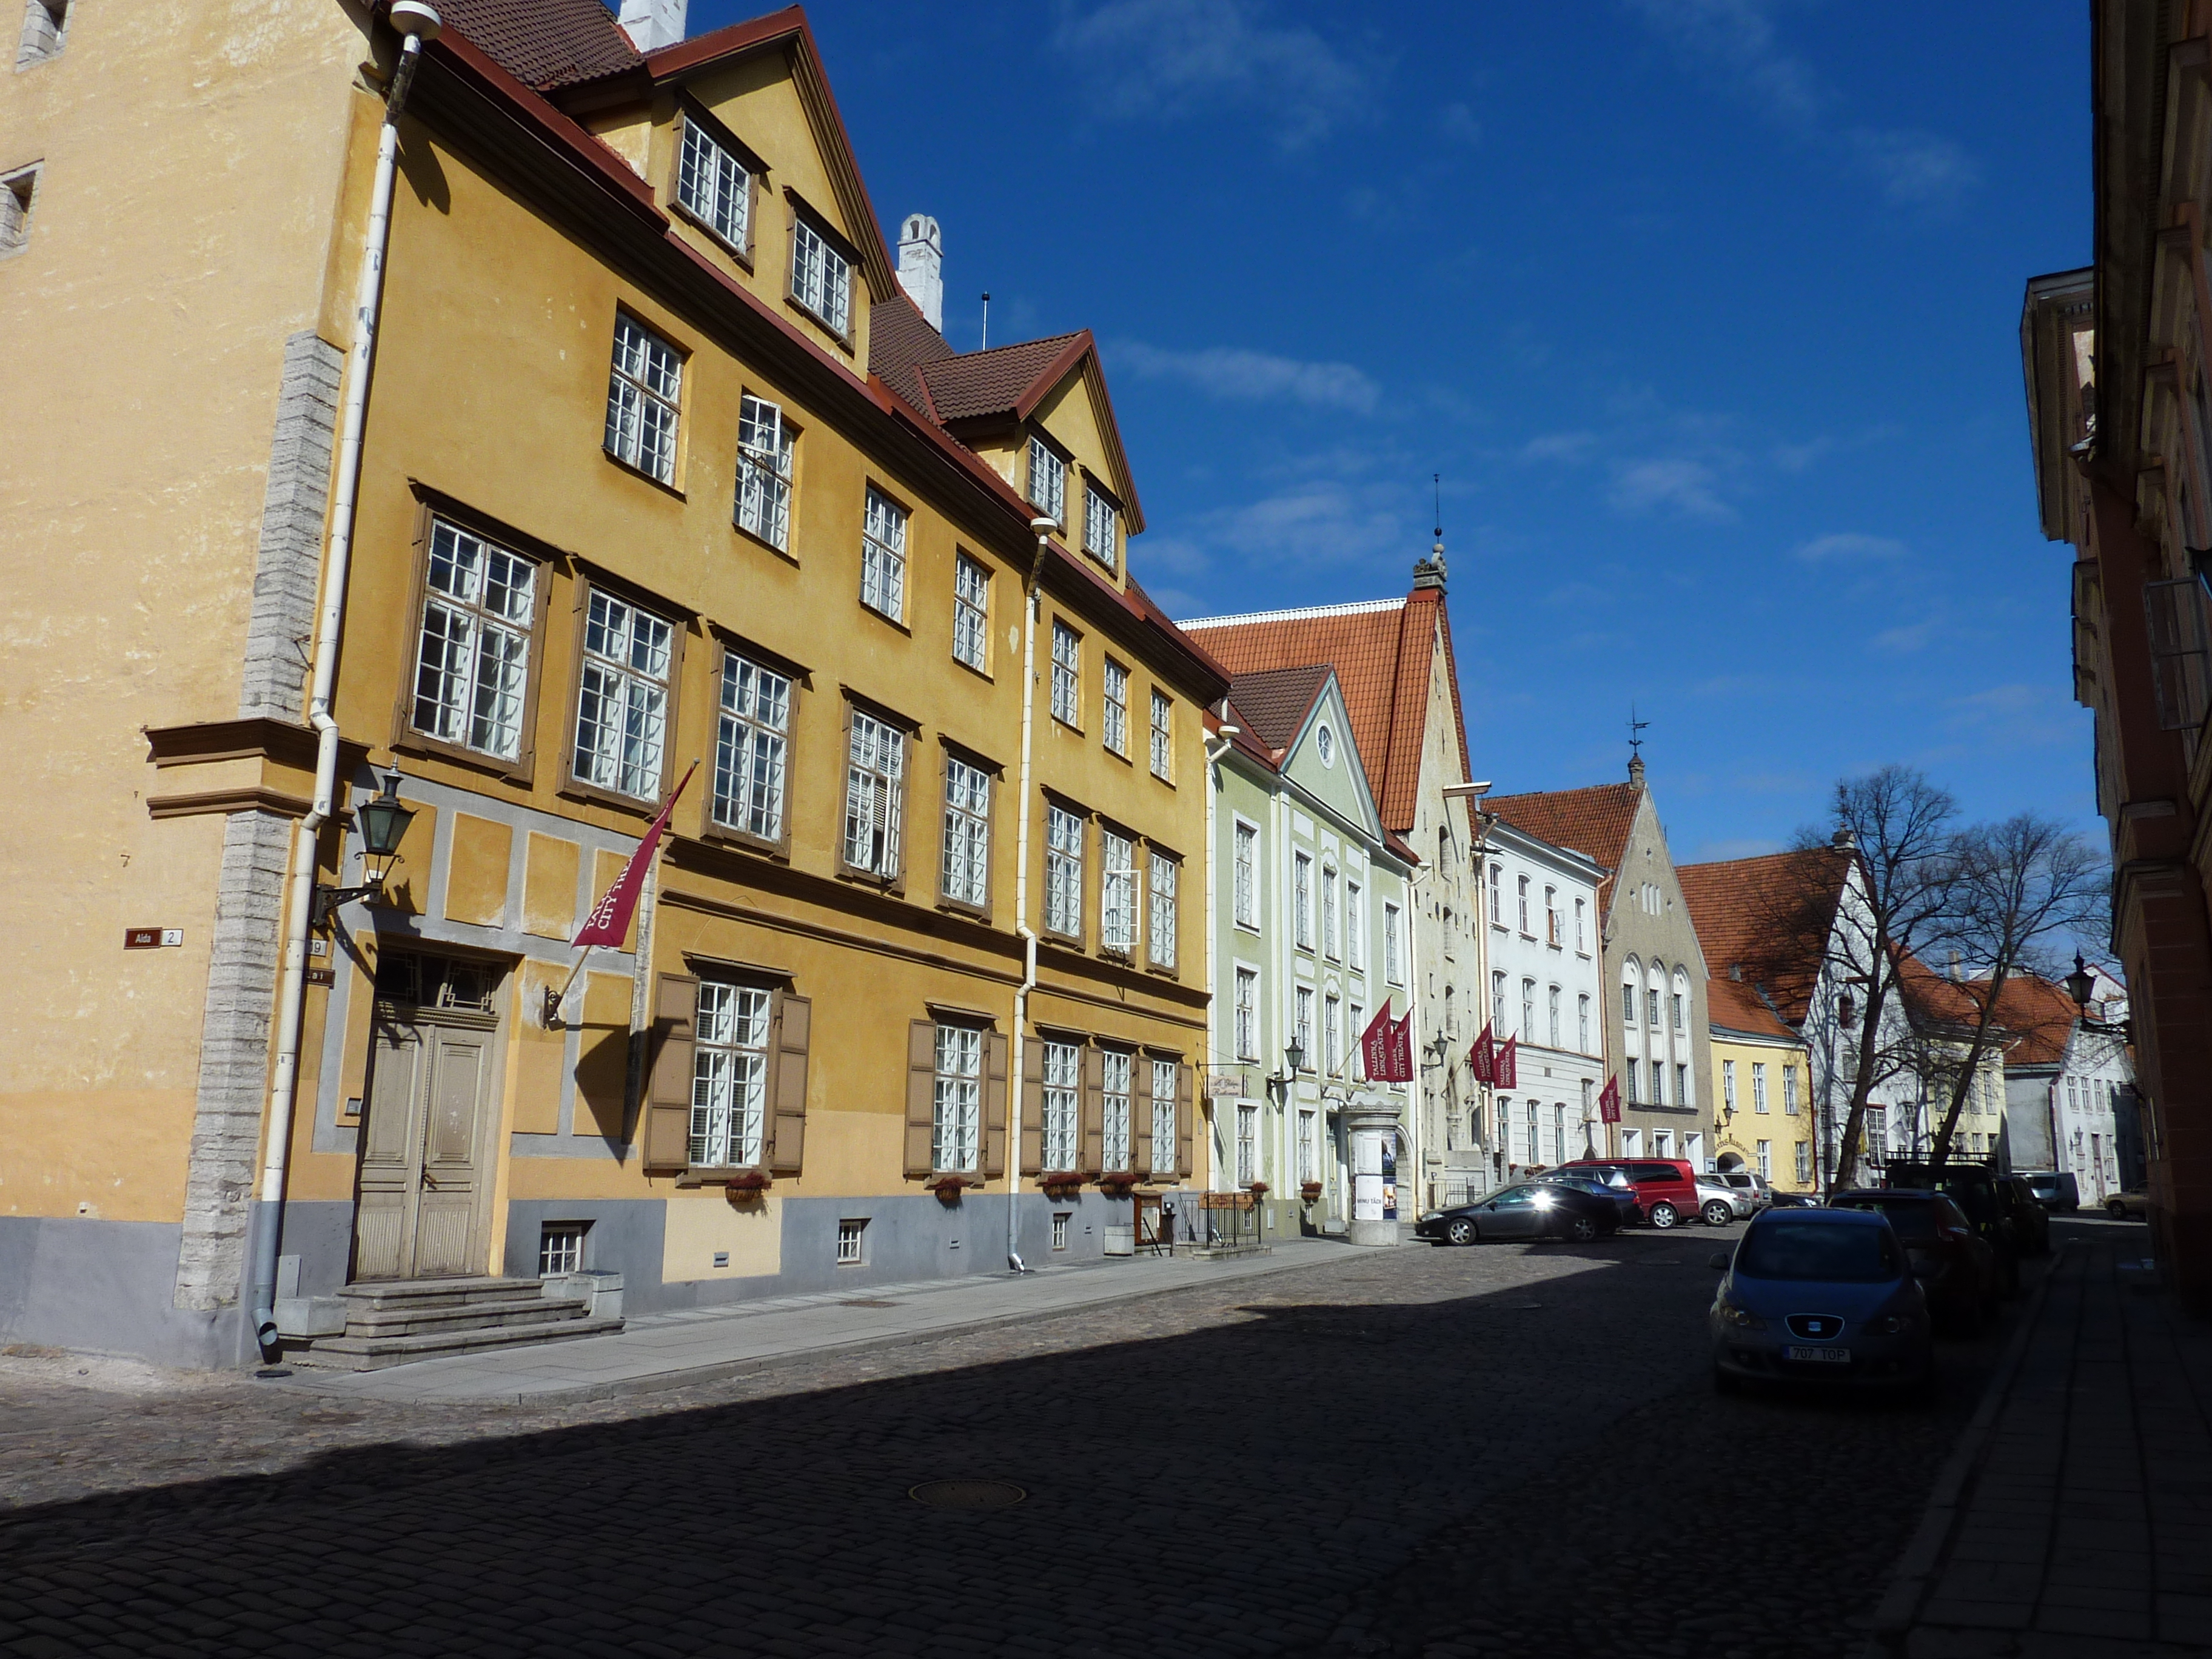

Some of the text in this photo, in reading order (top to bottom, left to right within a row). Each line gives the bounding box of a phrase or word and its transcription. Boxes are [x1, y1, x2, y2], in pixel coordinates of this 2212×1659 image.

[598, 896, 617, 930] CITY
[135, 933, 151, 943] Aida
[167, 932, 175, 943] 2
[1370, 1040, 1379, 1076] TALLINNA
[1377, 1022, 1387, 1076] LINNATEATER
[1398, 1028, 1406, 1062] THEATRE
[1794, 1347, 1845, 1361] 707 TOP
